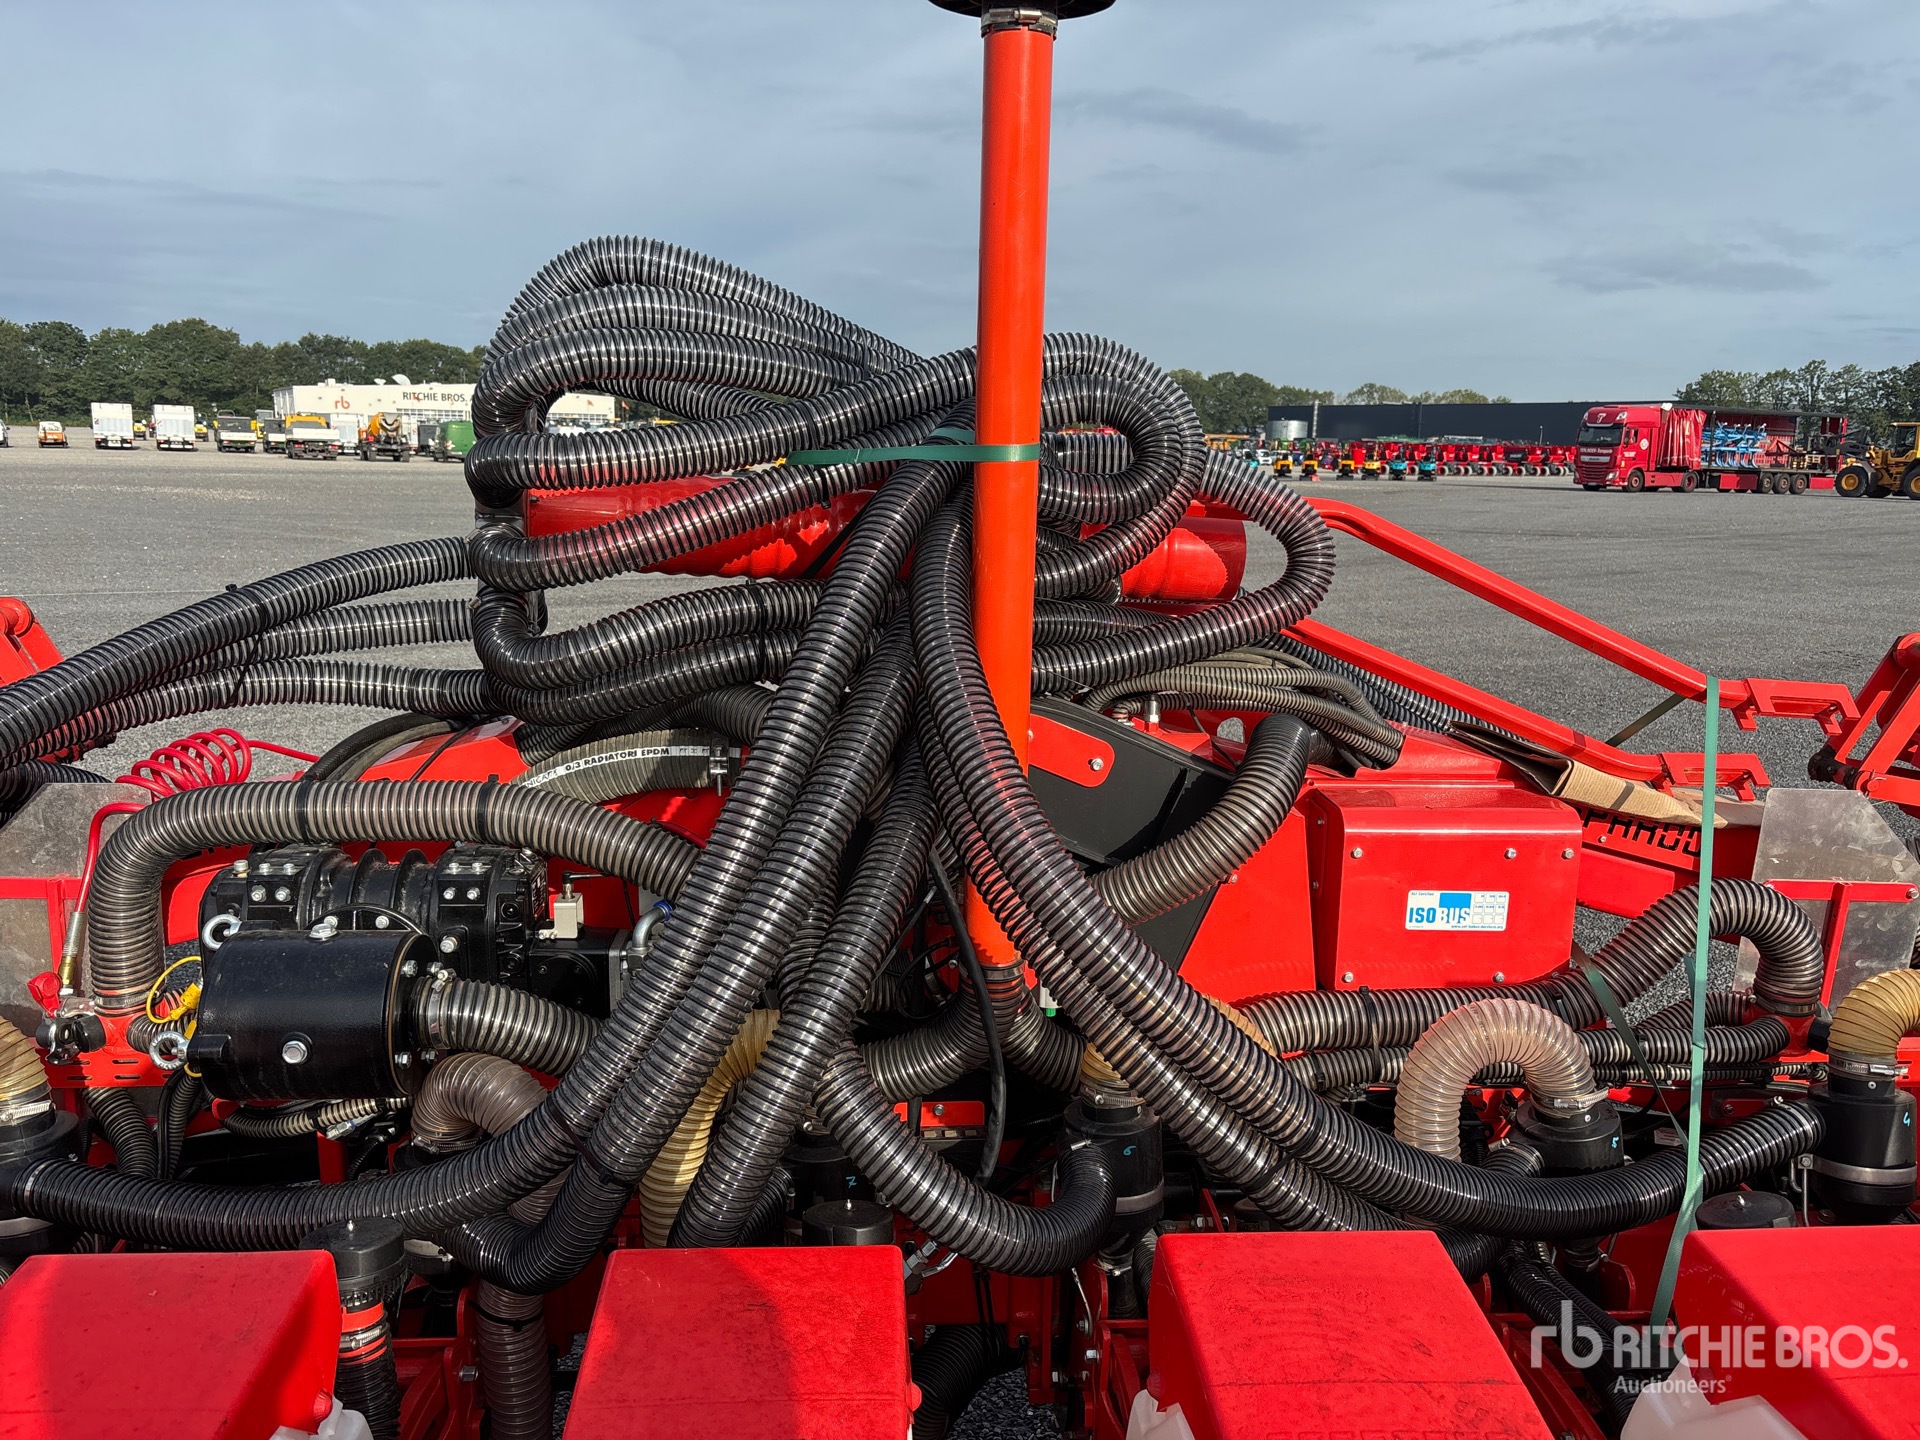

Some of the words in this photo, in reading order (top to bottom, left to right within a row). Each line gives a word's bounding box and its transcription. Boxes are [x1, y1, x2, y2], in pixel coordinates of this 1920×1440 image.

[335, 395, 350, 410] rb
[403, 391, 439, 402] RITCHIE
[441, 393, 468, 403] BROS.
[565, 761, 581, 772] 0/3
[583, 749, 637, 766] RADIATORI
[641, 747, 670, 757] EPDM
[1123, 1145, 1136, 1156] 6
[845, 1175, 857, 1188] 7
